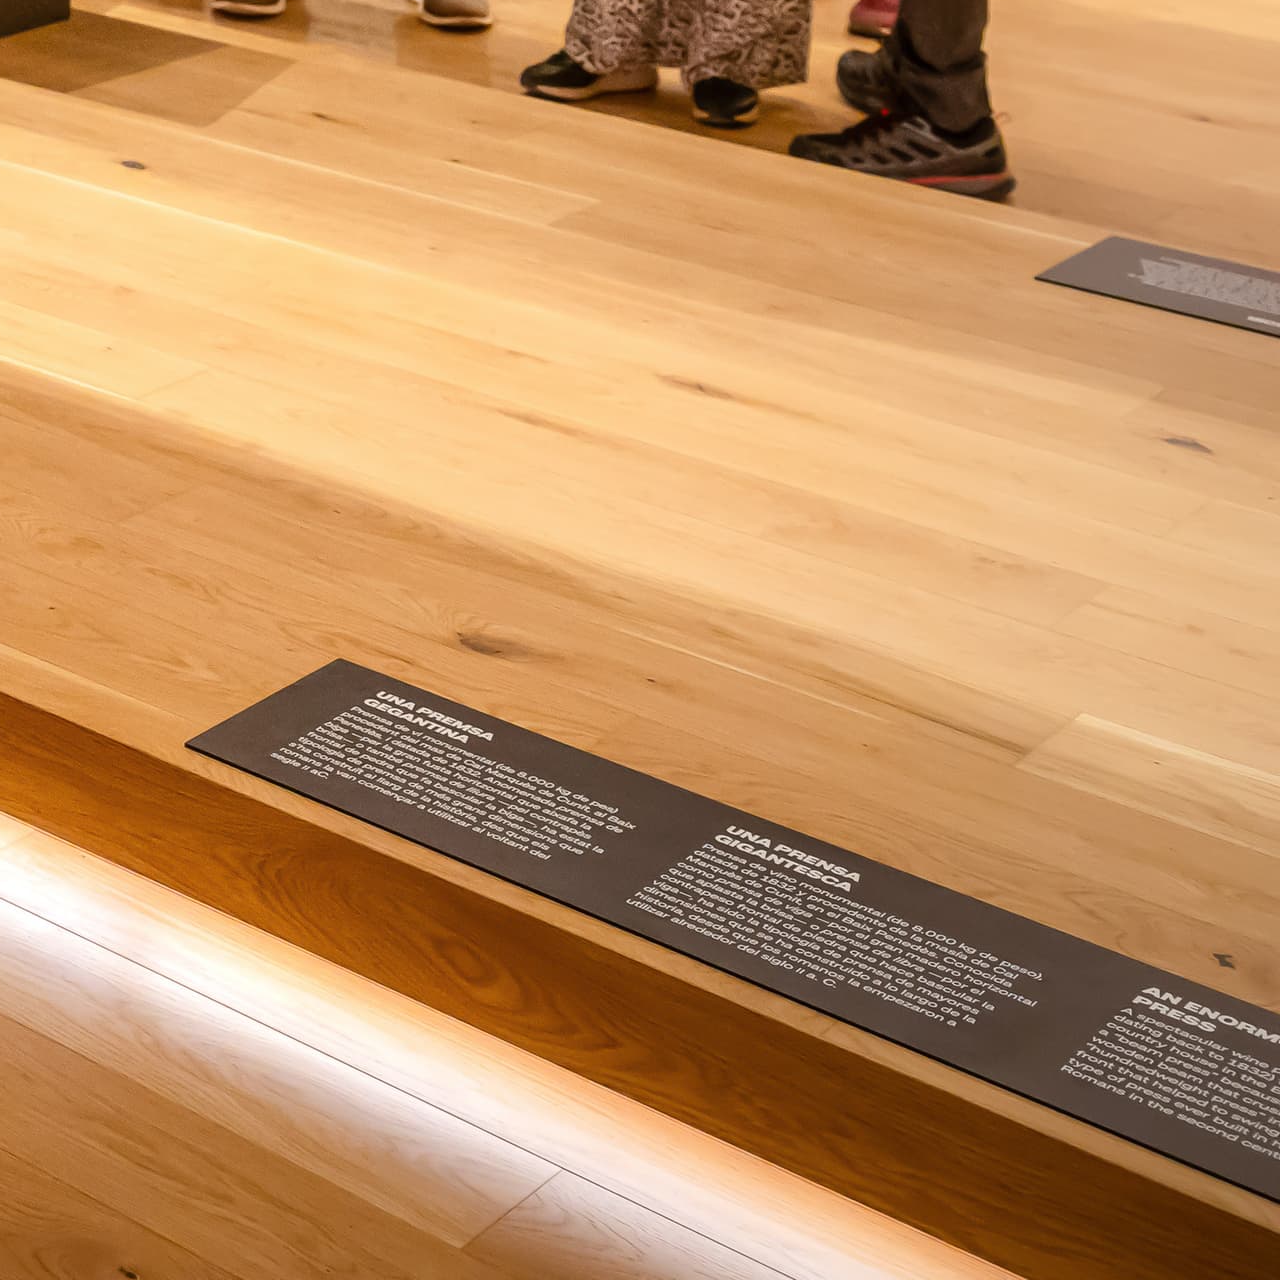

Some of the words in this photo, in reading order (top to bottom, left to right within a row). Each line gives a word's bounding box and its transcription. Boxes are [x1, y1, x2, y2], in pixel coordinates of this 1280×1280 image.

[350, 706, 393, 726] Premsa
[422, 735, 497, 766] monumental
[364, 699, 469, 743] GEGANTINA
[376, 691, 415, 711] UNA
[416, 707, 494, 741] PREMSA
[280, 747, 322, 767] romans
[427, 808, 472, 827] utilitzar
[487, 831, 529, 851] voltant
[298, 737, 345, 758] tipologia
[362, 764, 407, 783] premsa
[451, 800, 487, 815] grans
[488, 814, 558, 844] dimensions
[307, 732, 346, 749] frontal
[359, 754, 395, 770] pedra
[433, 782, 485, 805] bascular
[559, 834, 591, 848] estat
[324, 721, 349, 734] biga
[393, 750, 421, 762] gran
[422, 760, 452, 775] fusta
[453, 772, 518, 800] horitzontal
[542, 809, 578, 825] aixafa
[715, 835, 851, 892] GIGANTESCA
[726, 825, 771, 848] UNA
[773, 844, 860, 882] PRENSA
[660, 874, 734, 906] contrapeso
[737, 904, 782, 924] frontal
[782, 923, 801, 932] de
[802, 931, 847, 951] piedra
[850, 950, 877, 963] que
[879, 960, 914, 978] hace
[917, 976, 980, 1003] bascular
[982, 1001, 995, 1011] la
[669, 868, 694, 880] que
[695, 879, 744, 900] aplasta
[746, 898, 758, 906] la
[819, 929, 870, 950] prensa
[872, 949, 891, 958] de
[893, 956, 925, 972] libra
[970, 988, 985, 996] el
[677, 862, 715, 879] como
[714, 878, 763, 898] prensa
[764, 897, 783, 905] de
[785, 904, 813, 918] viga
[869, 939, 903, 954] gran
[905, 952, 961, 976] madero
[964, 974, 1038, 1007] horizontal
[694, 850, 739, 870] datada
[741, 869, 759, 877] de
[760, 875, 796, 892] 1832
[807, 895, 887, 928] procedente
[889, 927, 908, 936] de
[910, 934, 923, 942] la
[971, 959, 990, 968] de
[993, 967, 1019, 979] Cal
[702, 843, 747, 864] Prensa
[749, 863, 767, 871] de
[770, 870, 797, 883] vino
[799, 882, 886, 918] monumental
[958, 943, 976, 954] kg
[979, 952, 998, 961] de
[745, 880, 763, 888] de
[806, 904, 824, 913] en
[842, 916, 873, 932] Baix
[943, 957, 1012, 988] Conocida
[1106, 1022, 1168, 1048] country
[1169, 1046, 1218, 1069] house
[1222, 1066, 1236, 1076] in
[1240, 1074, 1267, 1088] the
[1114, 1015, 1163, 1038] dating
[1166, 1034, 1205, 1054] back
[1208, 1051, 1224, 1061] to
[1132, 995, 1216, 1032] PRESS
[1137, 1014, 1229, 1051] spectacular
[1232, 1051, 1269, 1068] wine
[1142, 987, 1182, 1005] AN
[1183, 1001, 1280, 1044] ENORM
[1061, 1065, 1126, 1095] Romans
[1129, 1093, 1143, 1103] in
[1148, 1100, 1174, 1115] the
[1177, 1114, 1239, 1141] second
[1241, 1140, 1280, 1160] cent
[1069, 1058, 1104, 1075] type
[1107, 1075, 1126, 1083] of
[1125, 1082, 1171, 1103] press
[1174, 1102, 1210, 1118] ever
[1213, 1116, 1249, 1135] built
[1253, 1132, 1267, 1143] in
[1076, 1050, 1115, 1070] front
[1118, 1067, 1150, 1084] that
[1152, 1081, 1209, 1107] helped
[1211, 1105, 1228, 1115] to
[1231, 1114, 1280, 1137] swing
[1093, 1036, 1154, 1064] wooden
[1157, 1062, 1203, 1084] beam
[1208, 1081, 1240, 1099] that
[1242, 1097, 1280, 1116] crus
[1220, 1077, 1280, 1105] becaus
